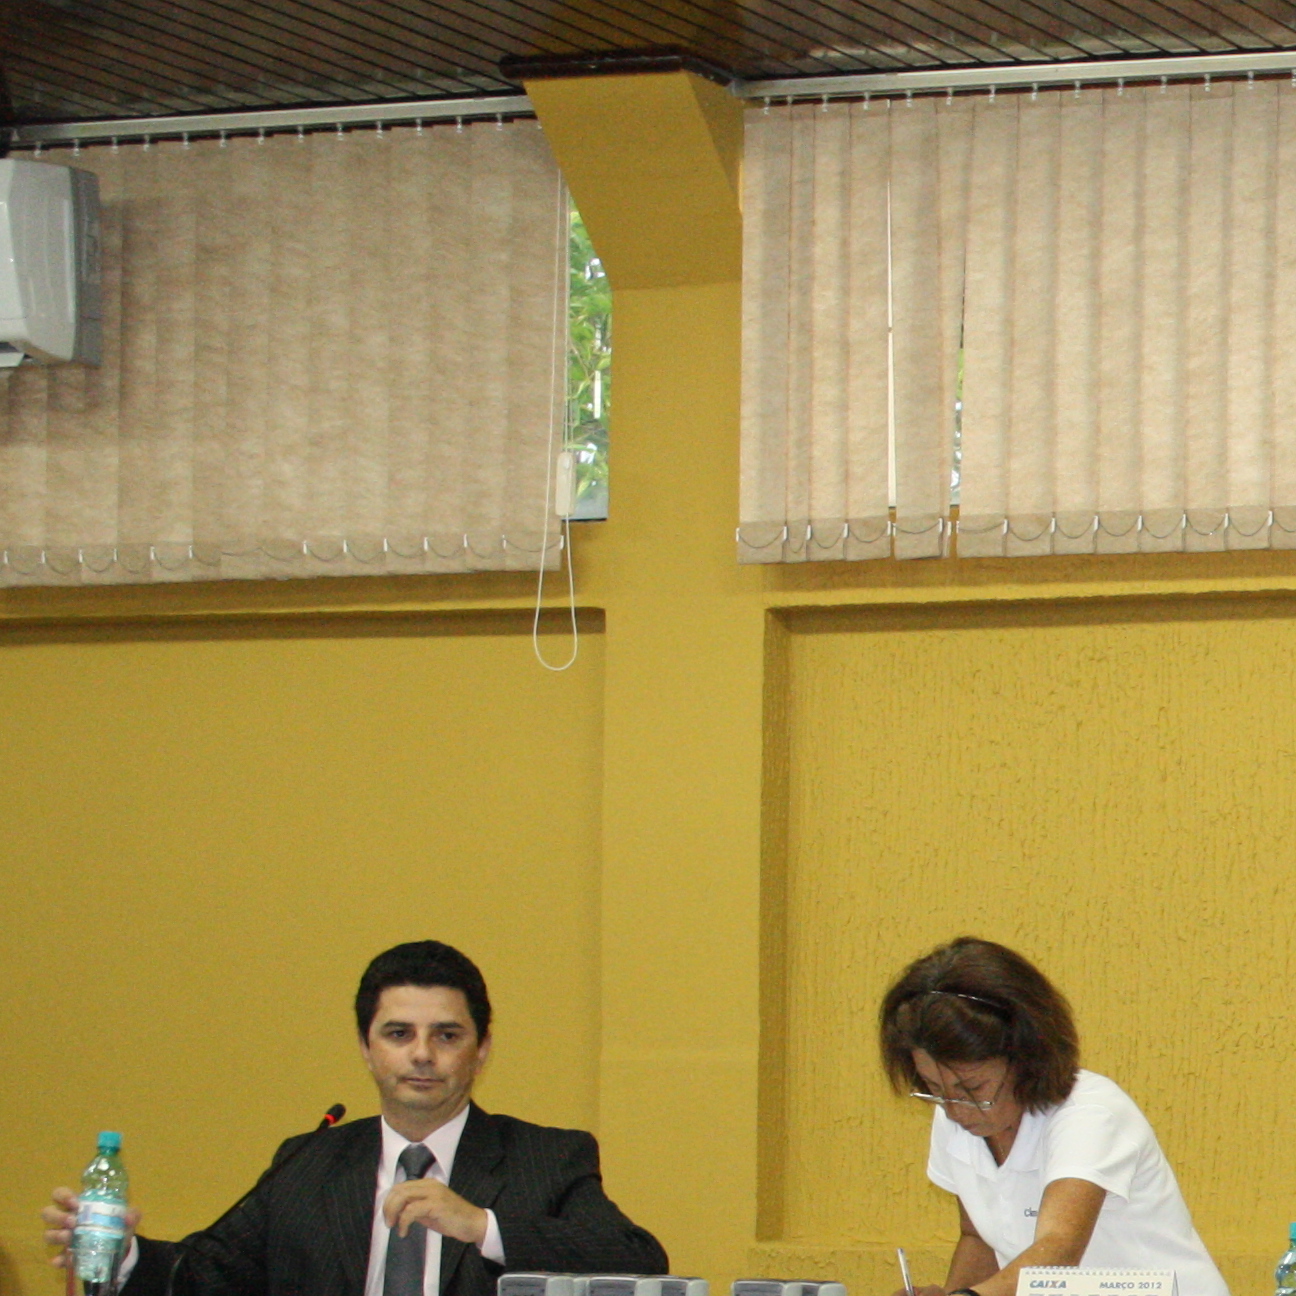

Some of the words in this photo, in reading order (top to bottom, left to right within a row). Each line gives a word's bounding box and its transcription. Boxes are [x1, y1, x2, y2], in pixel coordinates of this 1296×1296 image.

[1029, 1280, 1067, 1289] CAIXA
[1099, 1282, 1135, 1291] MARÇO
[1138, 1282, 1162, 1290] 2012
